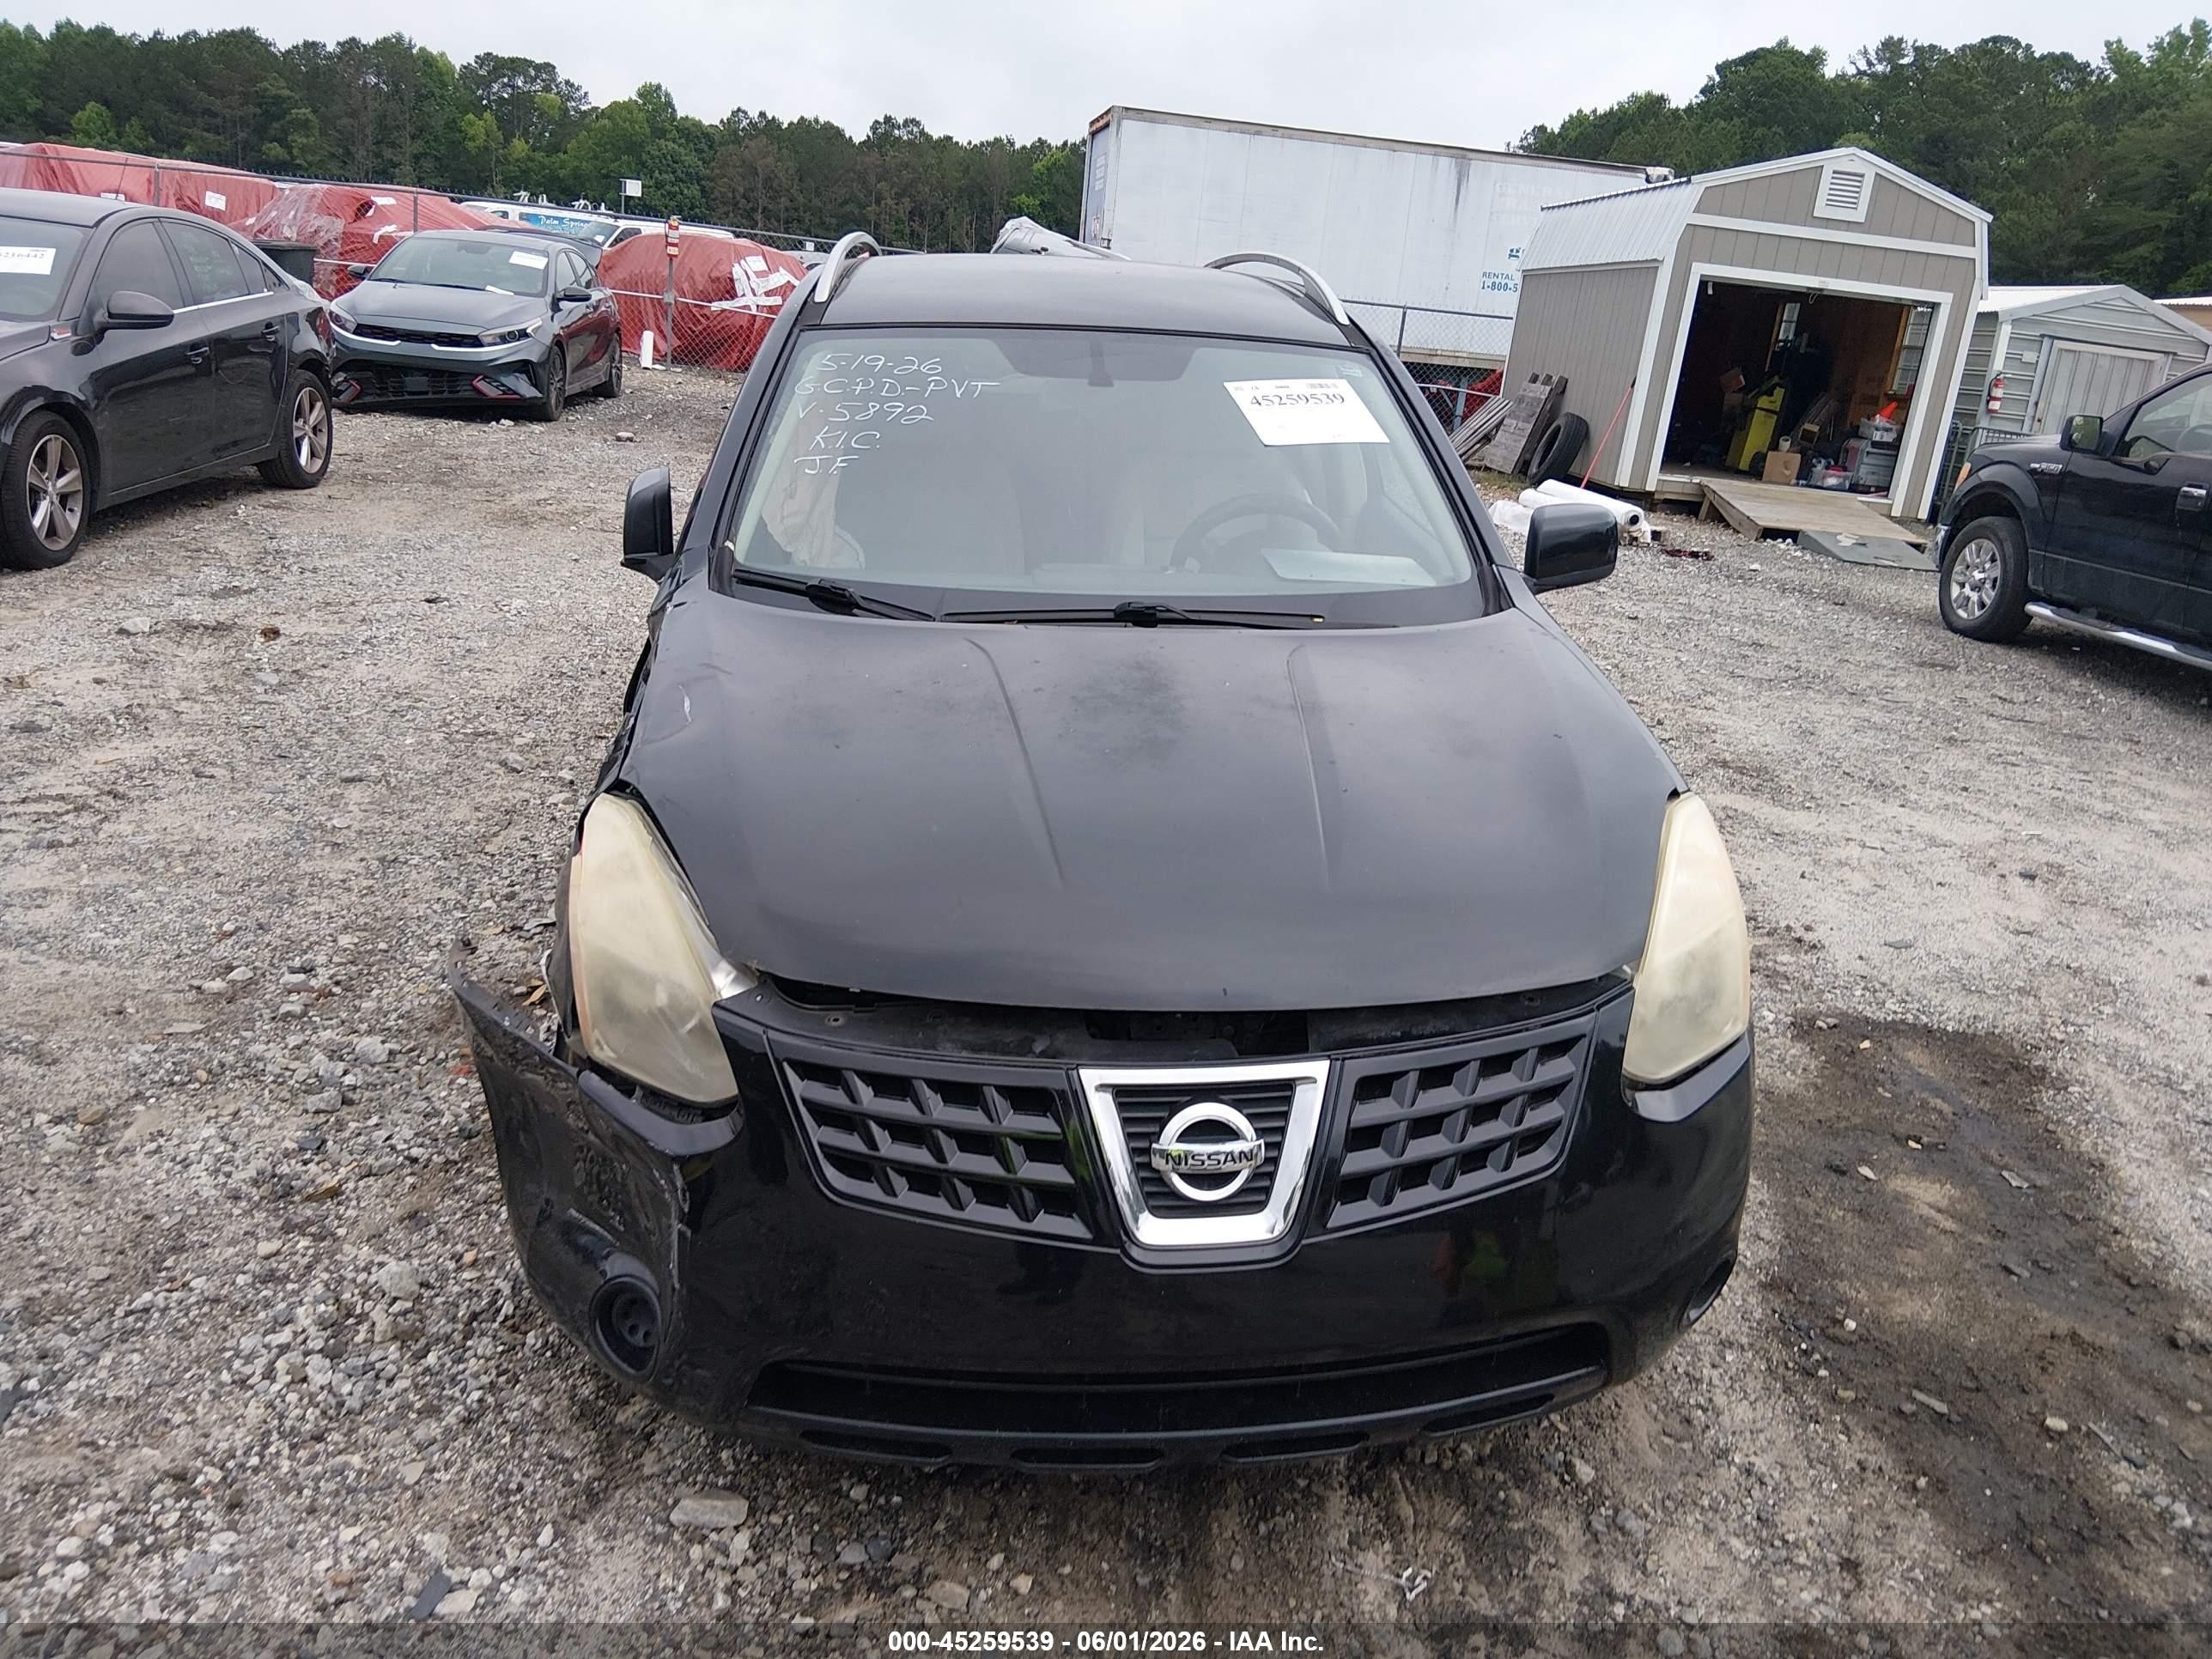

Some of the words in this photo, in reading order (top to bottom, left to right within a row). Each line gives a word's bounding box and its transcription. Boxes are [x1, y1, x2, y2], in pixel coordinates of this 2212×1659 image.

[1482, 271, 1515, 281] RENTAL
[817, 353, 943, 374] 5-19-26
[1250, 393, 1346, 406] 45259539
[1164, 1150, 1254, 1167] NISSAN
